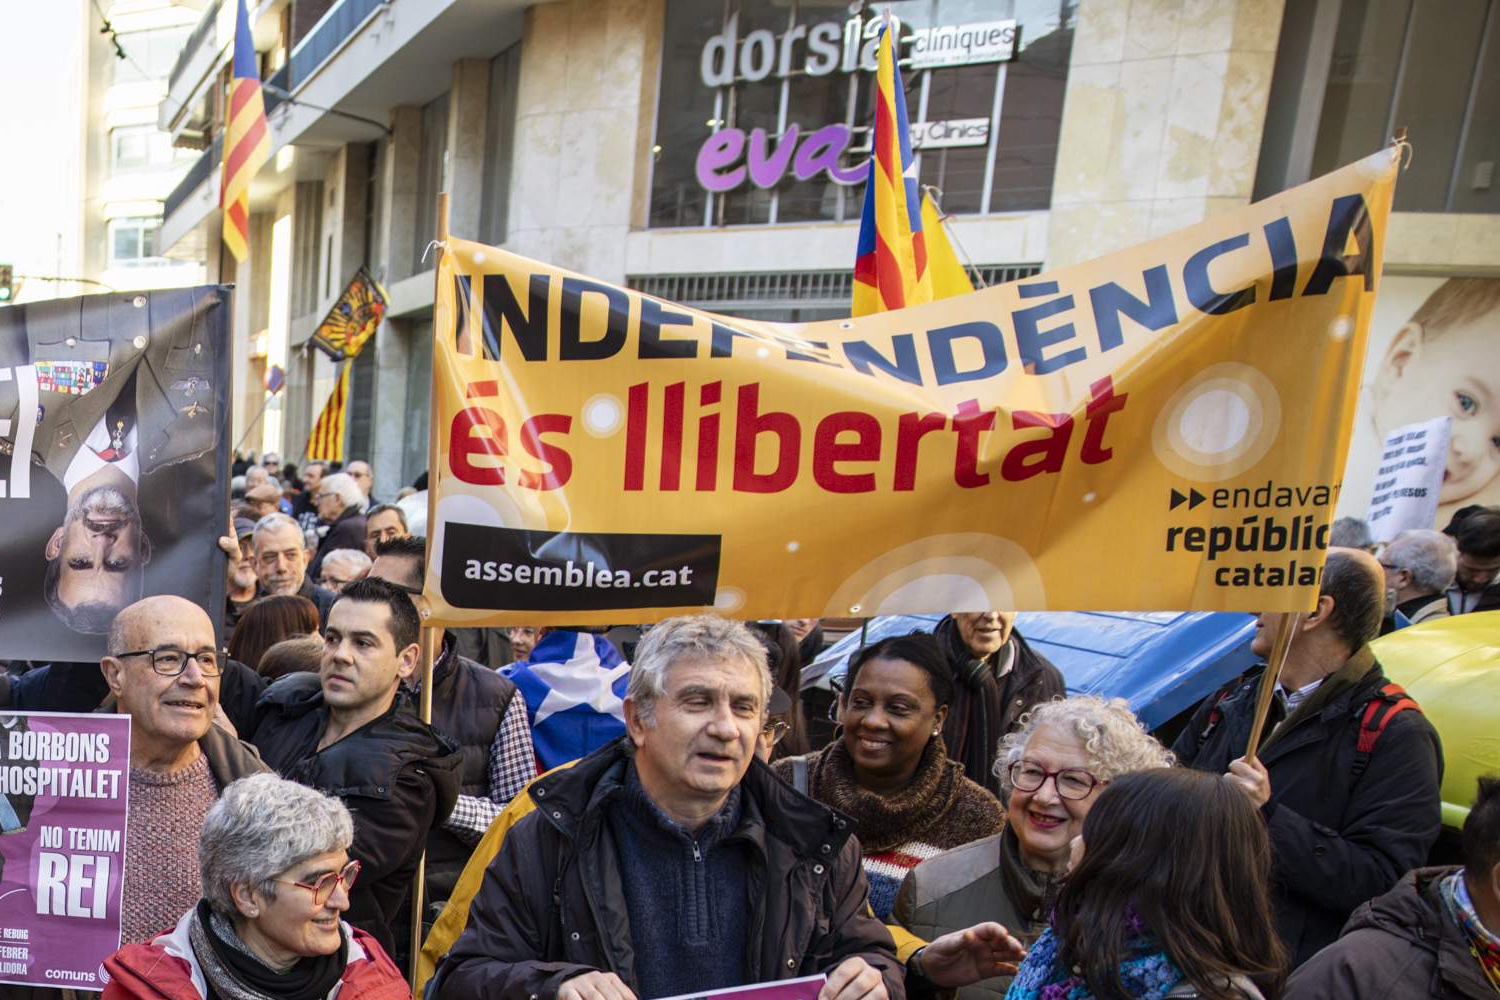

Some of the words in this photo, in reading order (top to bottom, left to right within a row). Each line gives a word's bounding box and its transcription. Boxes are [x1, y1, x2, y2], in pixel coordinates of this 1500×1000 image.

[915, 25, 1014, 54] cliniques
[696, 124, 873, 192] eva
[929, 120, 989, 140] Clinics
[449, 380, 573, 491] és
[623, 374, 1129, 494] llibertat
[1167, 514, 1330, 561] repúblic
[464, 558, 693, 589] assemblea.cat
[8, 730, 110, 764] BORBONS
[40, 826, 63, 849] NO
[68, 827, 121, 853] TENIM
[36, 852, 110, 920] REI
[3, 928, 29, 939] REBUIG
[45, 967, 95, 983] comuns
